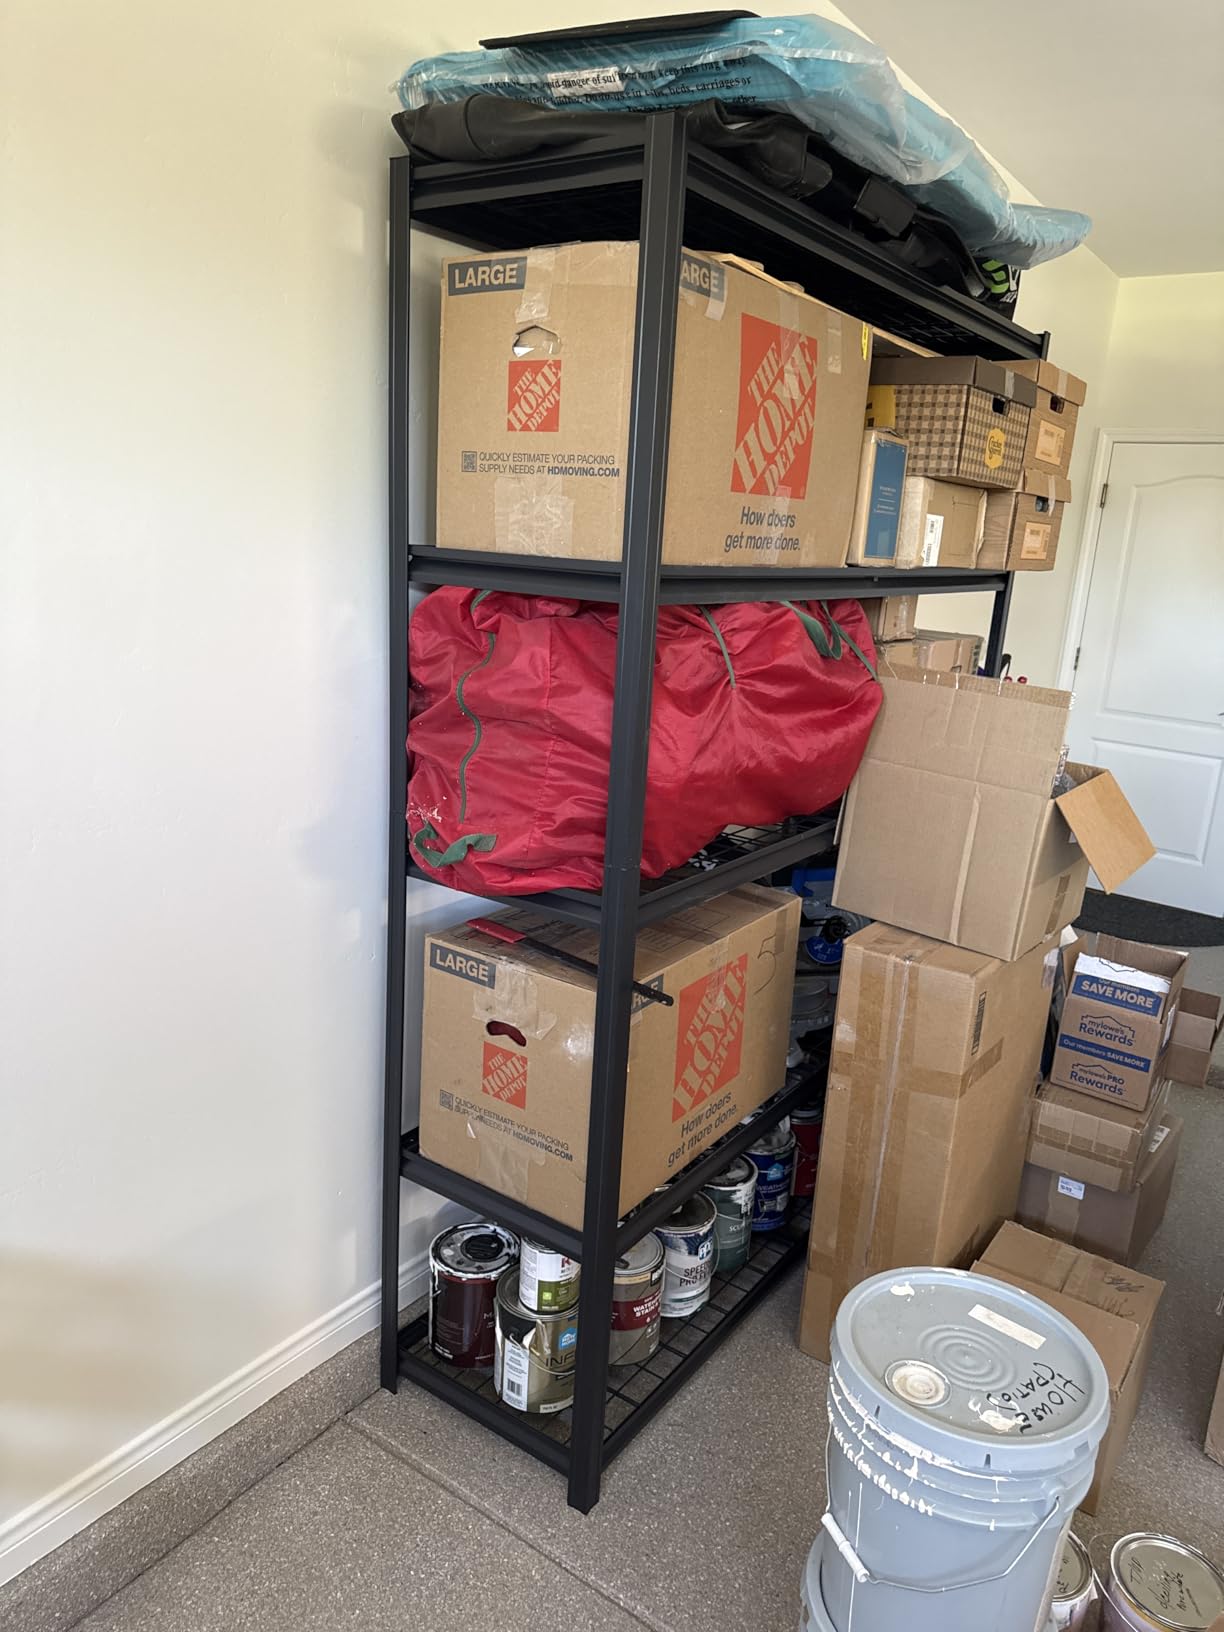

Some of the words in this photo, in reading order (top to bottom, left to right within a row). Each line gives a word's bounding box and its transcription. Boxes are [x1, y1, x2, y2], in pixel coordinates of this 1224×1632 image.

[560, 77, 590, 90] danger
[592, 74, 600, 85] of
[669, 84, 693, 95] beds,
[695, 79, 740, 92] carriages
[740, 76, 752, 86] or
[454, 263, 519, 289] LARGE
[680, 259, 720, 293] ARGE
[512, 367, 536, 399] THE
[747, 340, 784, 407] THE
[507, 360, 562, 432] HOME
[526, 386, 561, 432] DEPOT
[734, 332, 818, 494] HOME
[479, 451, 511, 462] QUICKLY
[512, 452, 550, 464] ESTIMATE
[551, 454, 575, 465] YOUR
[576, 454, 615, 465] PACKING
[763, 397, 815, 497] DEPOT
[478, 463, 507, 473] SUPPLY
[508, 464, 535, 475] NEEDS
[536, 465, 546, 475] AT
[547, 466, 620, 478] HDMOVING.COM
[740, 505, 765, 526] How
[767, 508, 796, 528] doers
[724, 533, 745, 552] get
[745, 535, 773, 550] more
[435, 948, 489, 982] LARGE
[1081, 980, 1114, 998] SAVE
[1114, 990, 1154, 1009] MORE
[1078, 1022, 1134, 1047] Rewards
[488, 1051, 506, 1070] THE
[1106, 1050, 1125, 1061] SAVE
[1124, 1056, 1146, 1068] MORE
[482, 1054, 528, 1096] HOME
[499, 1074, 527, 1101] DEPOT
[1069, 1070, 1123, 1096] Rewards
[1106, 1073, 1125, 1085] PRO
[455, 1096, 483, 1114] QUICKLY
[483, 1109, 516, 1126] ESTIMATE
[516, 1121, 537, 1137] YOUR
[537, 1131, 569, 1151] PACKING
[680, 1109, 704, 1138] How
[704, 1090, 732, 1120] doers
[502, 1125, 513, 1136] AT
[512, 1129, 573, 1162] HDMOVING.COM
[667, 1143, 686, 1168] get
[687, 1125, 714, 1148] more
